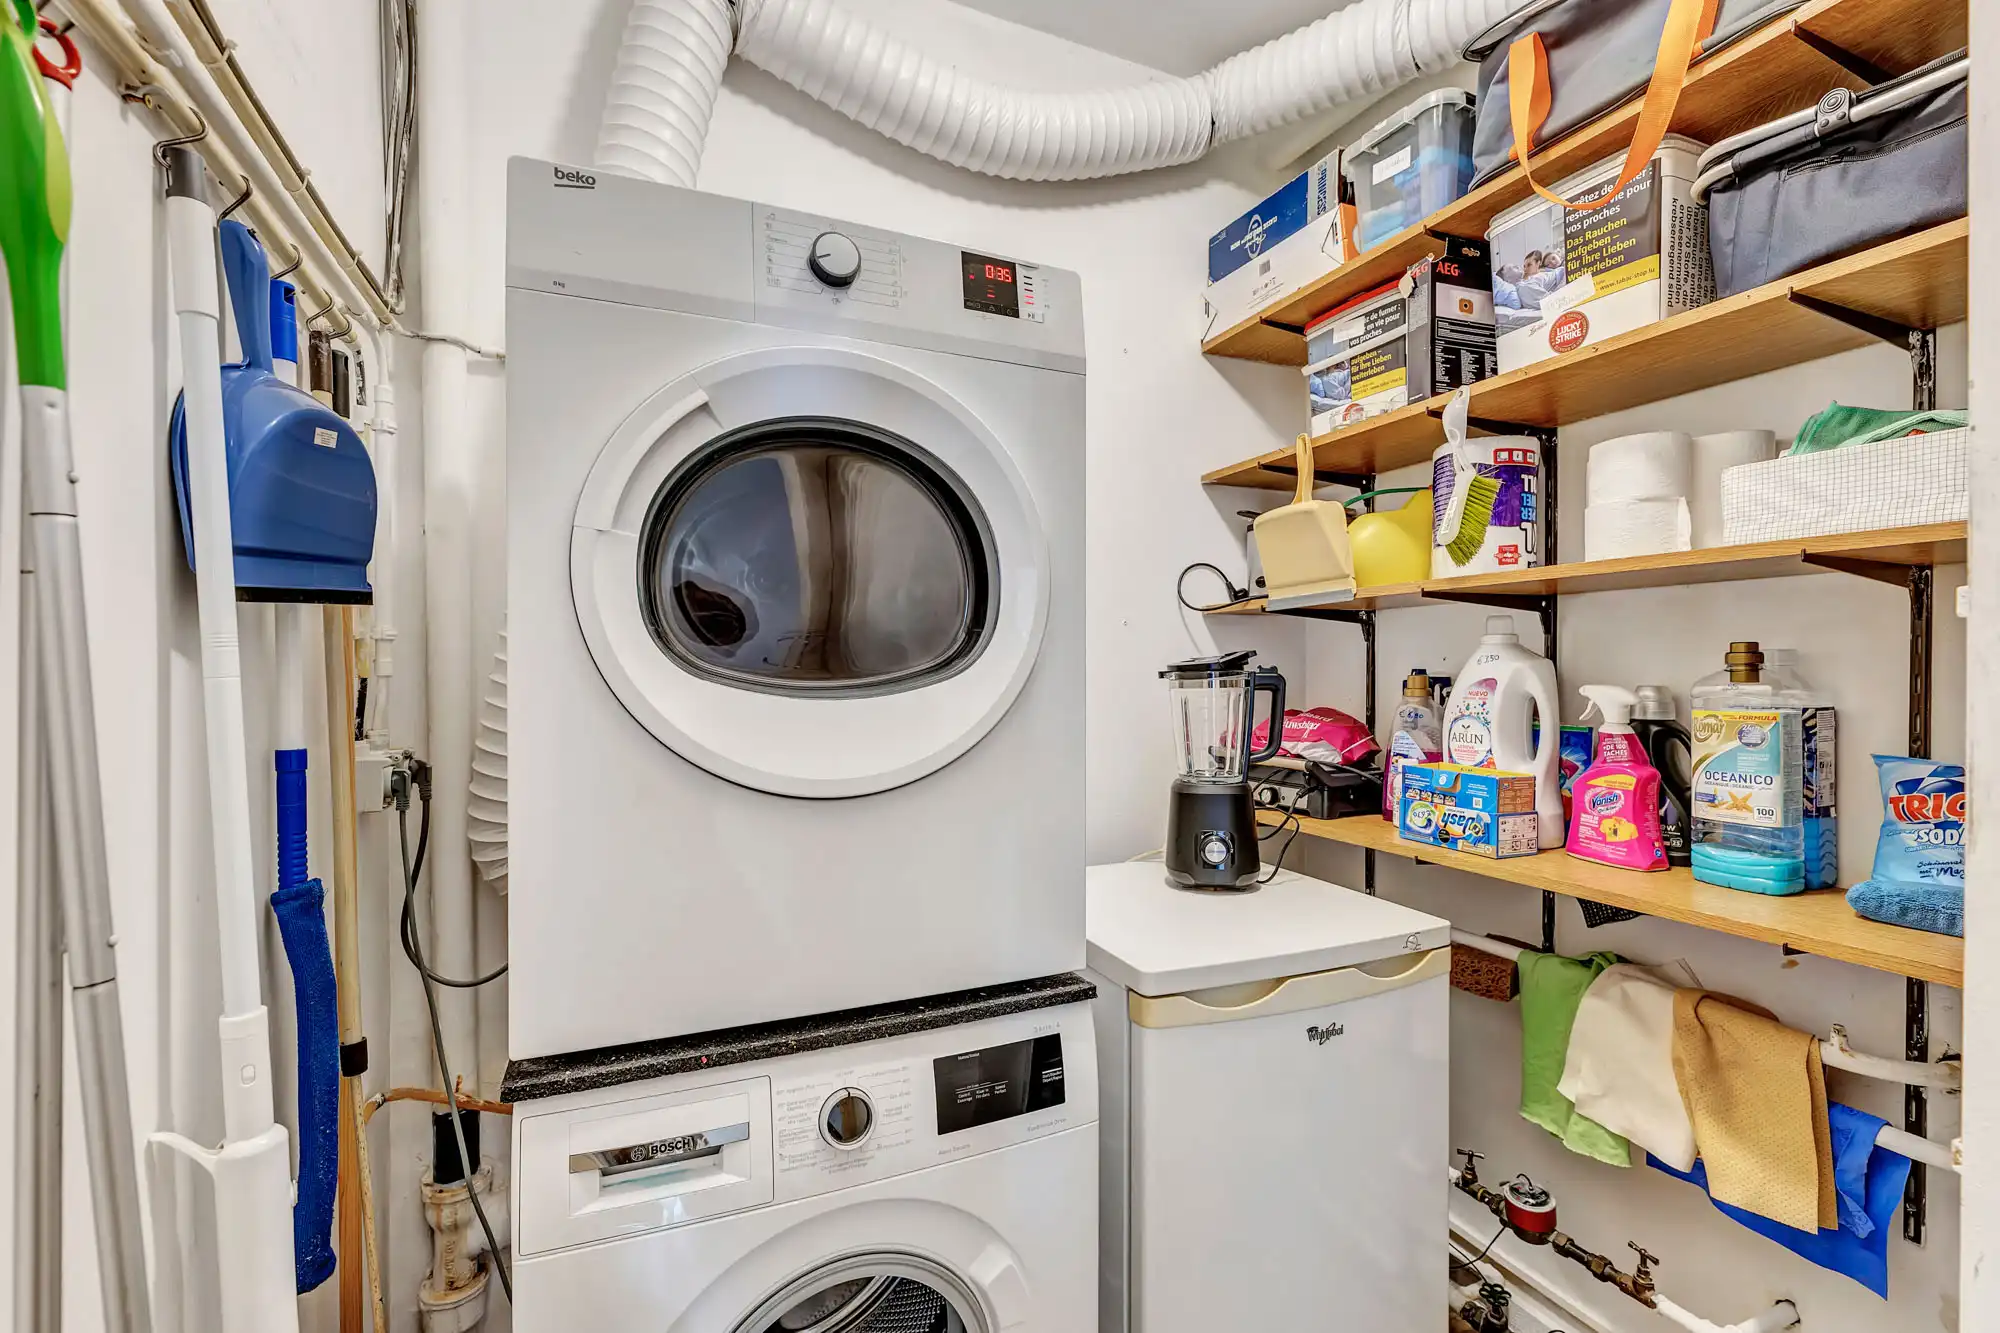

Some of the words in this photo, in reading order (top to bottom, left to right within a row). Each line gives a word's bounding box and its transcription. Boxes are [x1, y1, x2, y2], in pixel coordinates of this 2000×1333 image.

[554, 167, 596, 185] beko
[1316, 167, 1327, 216] PRINCESS
[1626, 180, 1652, 198] pour
[1566, 222, 1582, 234] vos
[1583, 204, 1621, 229] proches
[1566, 236, 1584, 249] Das
[1585, 218, 1628, 240] Rauchen
[1567, 235, 1611, 260] aufgeben
[1567, 259, 1580, 271] für
[1582, 252, 1601, 265] Ihre
[1602, 238, 1637, 259] Lieben
[1436, 261, 1459, 277] AEG
[1567, 254, 1625, 282] weiterleben
[1385, 312, 1401, 325] pour
[1556, 319, 1581, 335] LUCKY
[1350, 338, 1360, 347] vos
[1360, 328, 1382, 344] proches
[1555, 328, 1582, 345] STRIKE
[1372, 353, 1392, 366] Lieben
[1451, 731, 1484, 745] ARUN
[1603, 749, 1628, 757] TACHES
[1704, 770, 1774, 786] OCEANICO
[1592, 791, 1618, 809] Vanish
[1756, 808, 1775, 817] 100
[1441, 811, 1476, 835] Dash
[1306, 1022, 1344, 1046] Whirlpool
[650, 1138, 691, 1156] BOSCH
